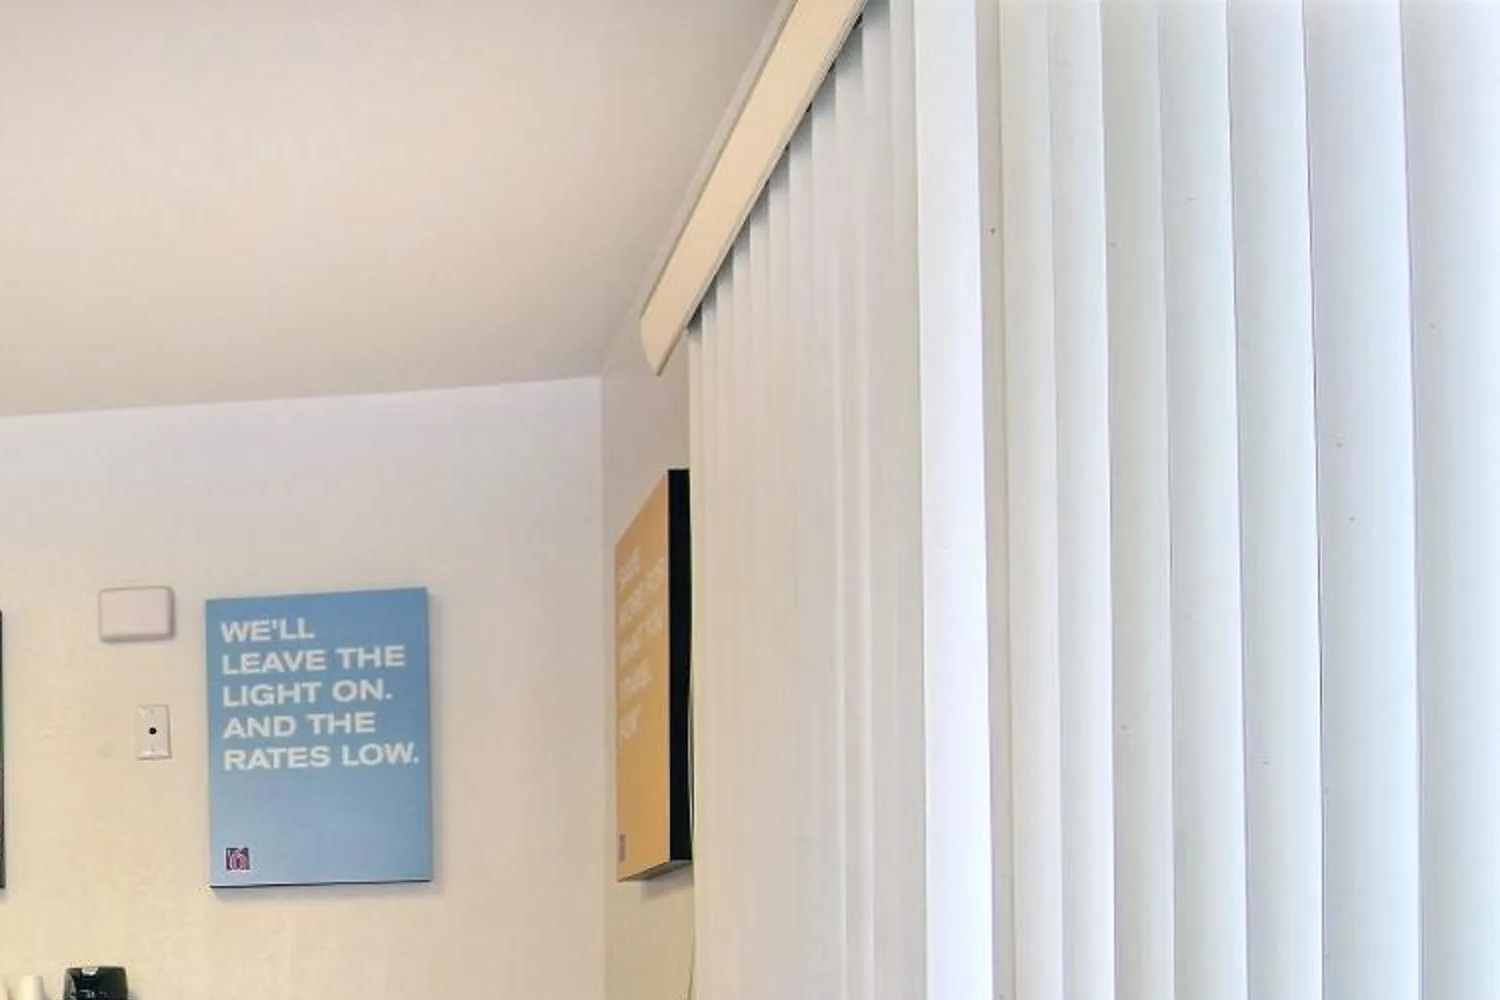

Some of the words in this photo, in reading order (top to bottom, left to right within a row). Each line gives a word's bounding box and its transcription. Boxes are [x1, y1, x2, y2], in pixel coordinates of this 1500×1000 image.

[220, 617, 315, 643] WE'LL
[222, 649, 327, 675] LEAVE
[335, 645, 406, 670] THE
[223, 682, 322, 708] LIGHT
[332, 678, 393, 702] ON.
[223, 715, 297, 739] AND
[307, 711, 376, 735] THE
[223, 745, 331, 772] RATES
[341, 741, 419, 767] LOW.
